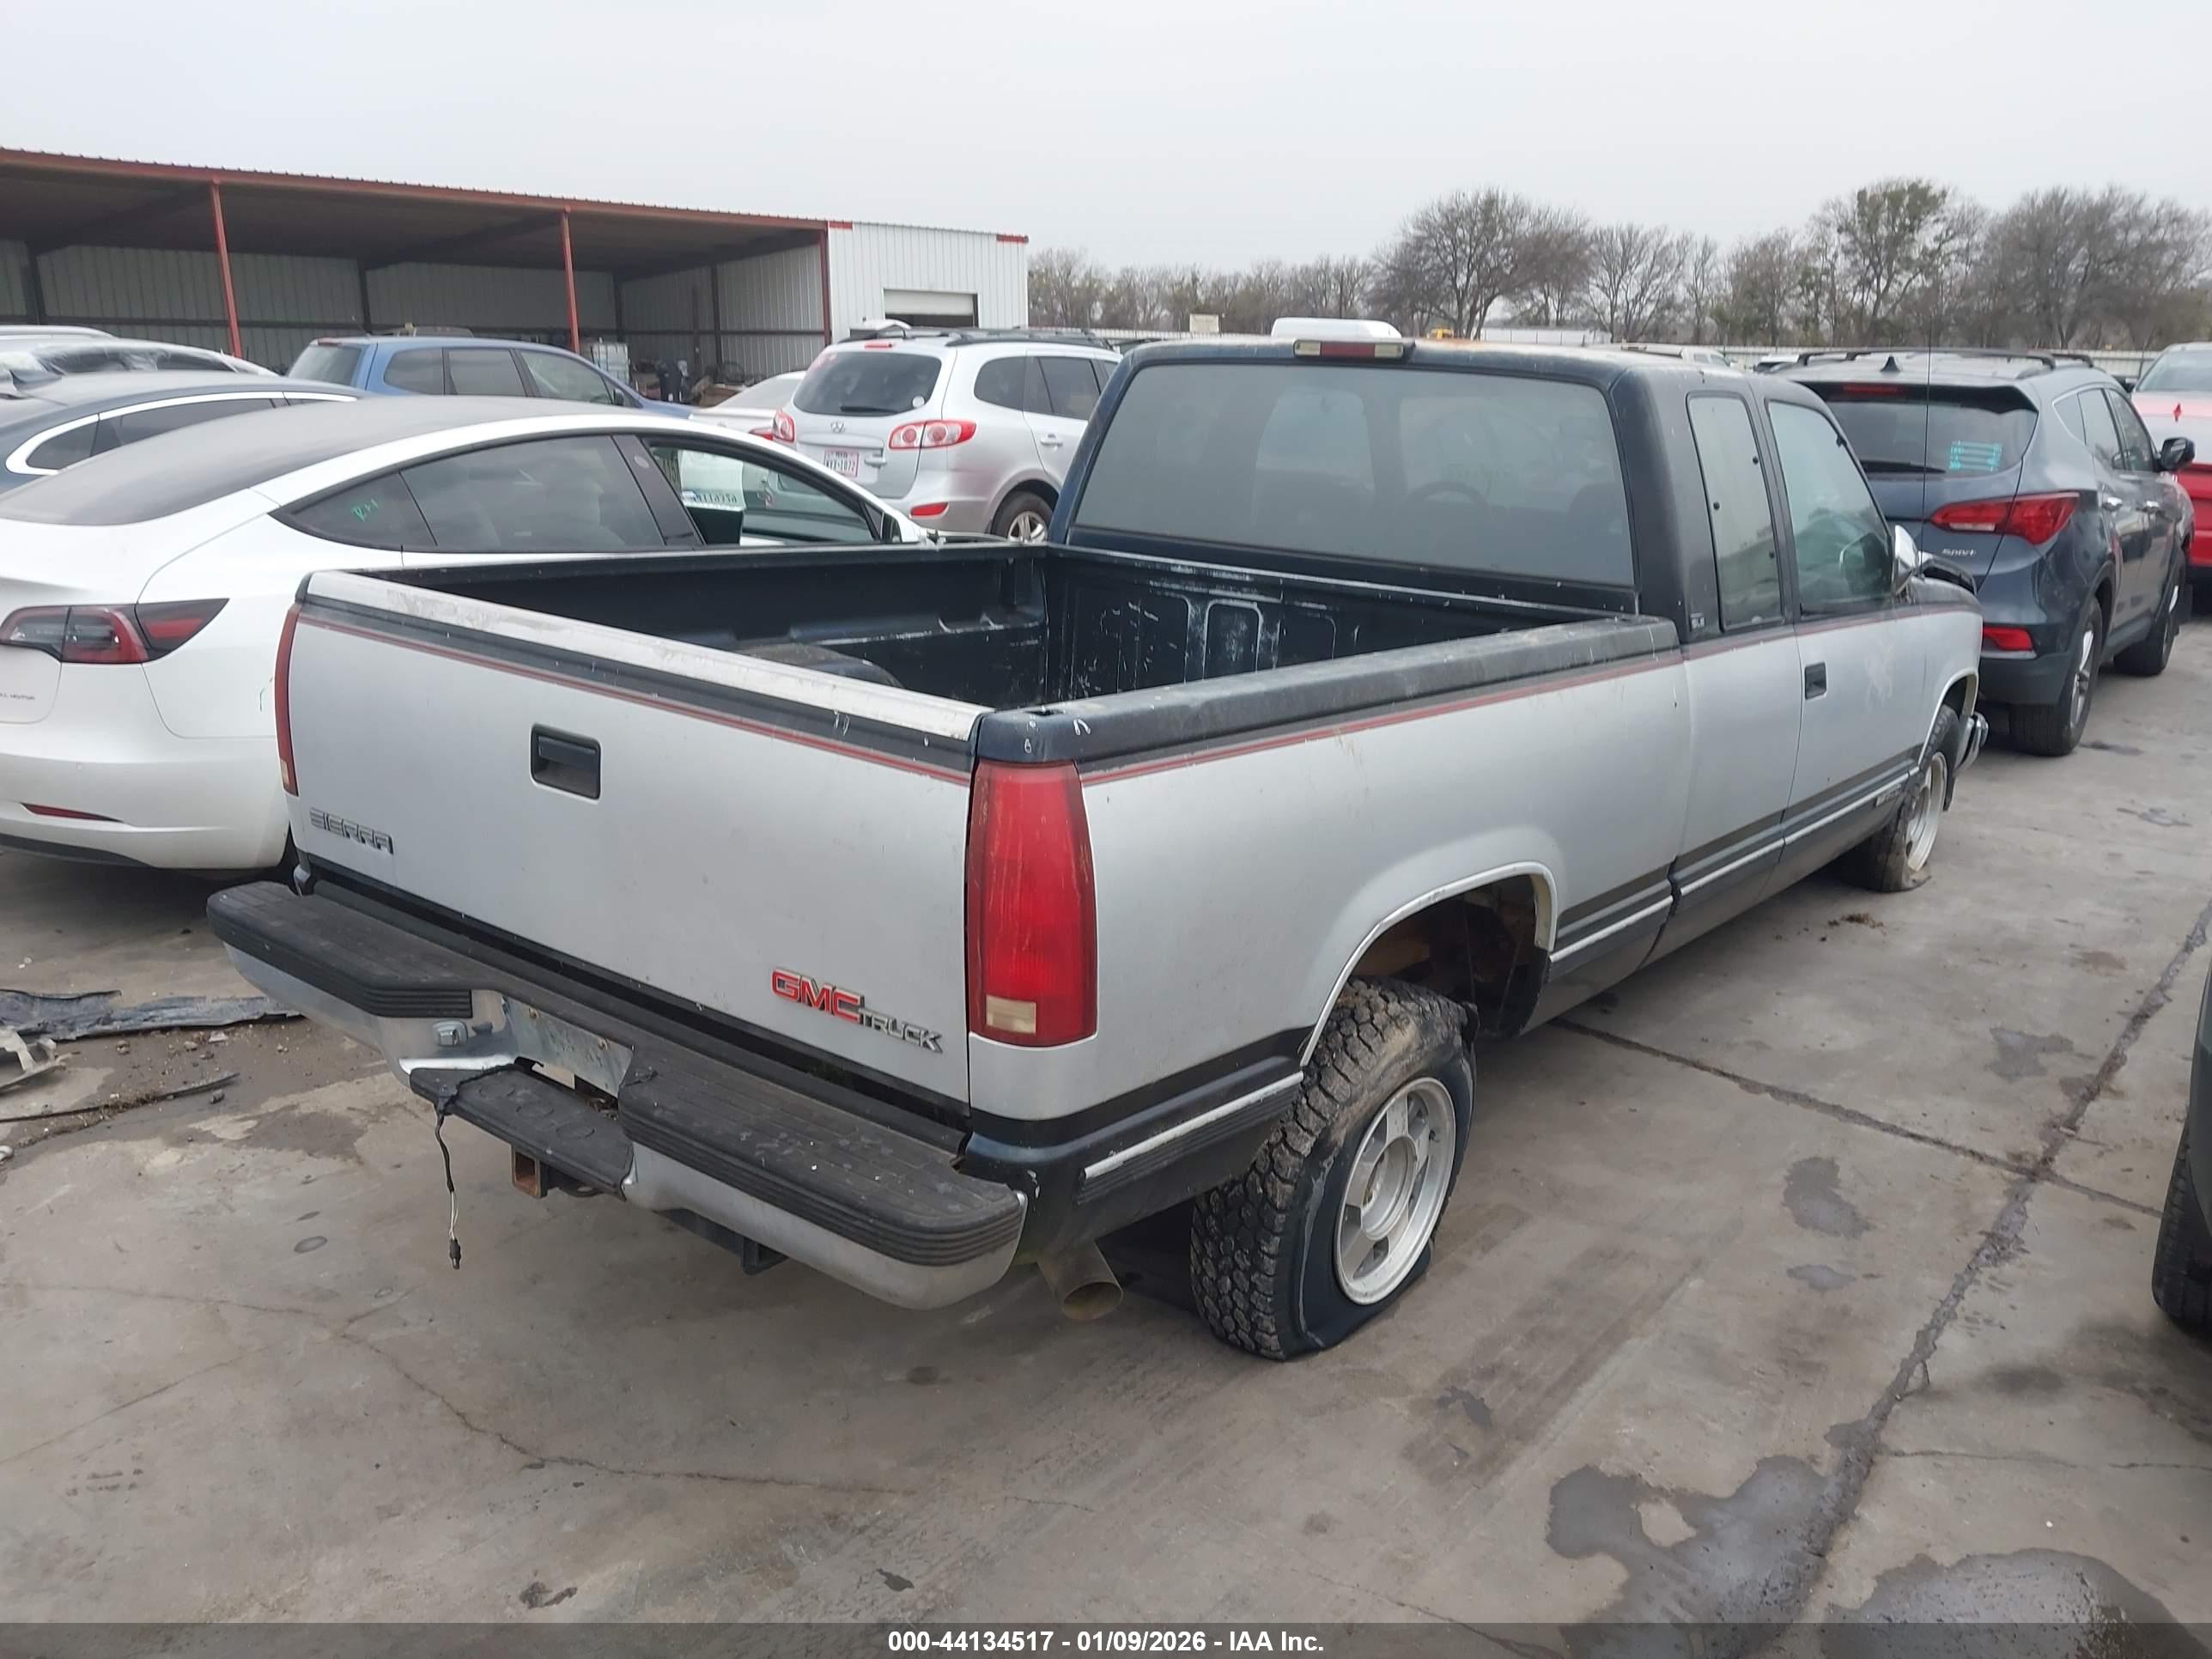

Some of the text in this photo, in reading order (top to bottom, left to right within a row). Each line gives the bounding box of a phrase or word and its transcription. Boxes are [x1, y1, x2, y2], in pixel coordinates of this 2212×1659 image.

[310, 806, 394, 855] SIERRA
[772, 968, 943, 1054] GMC TRUCK
